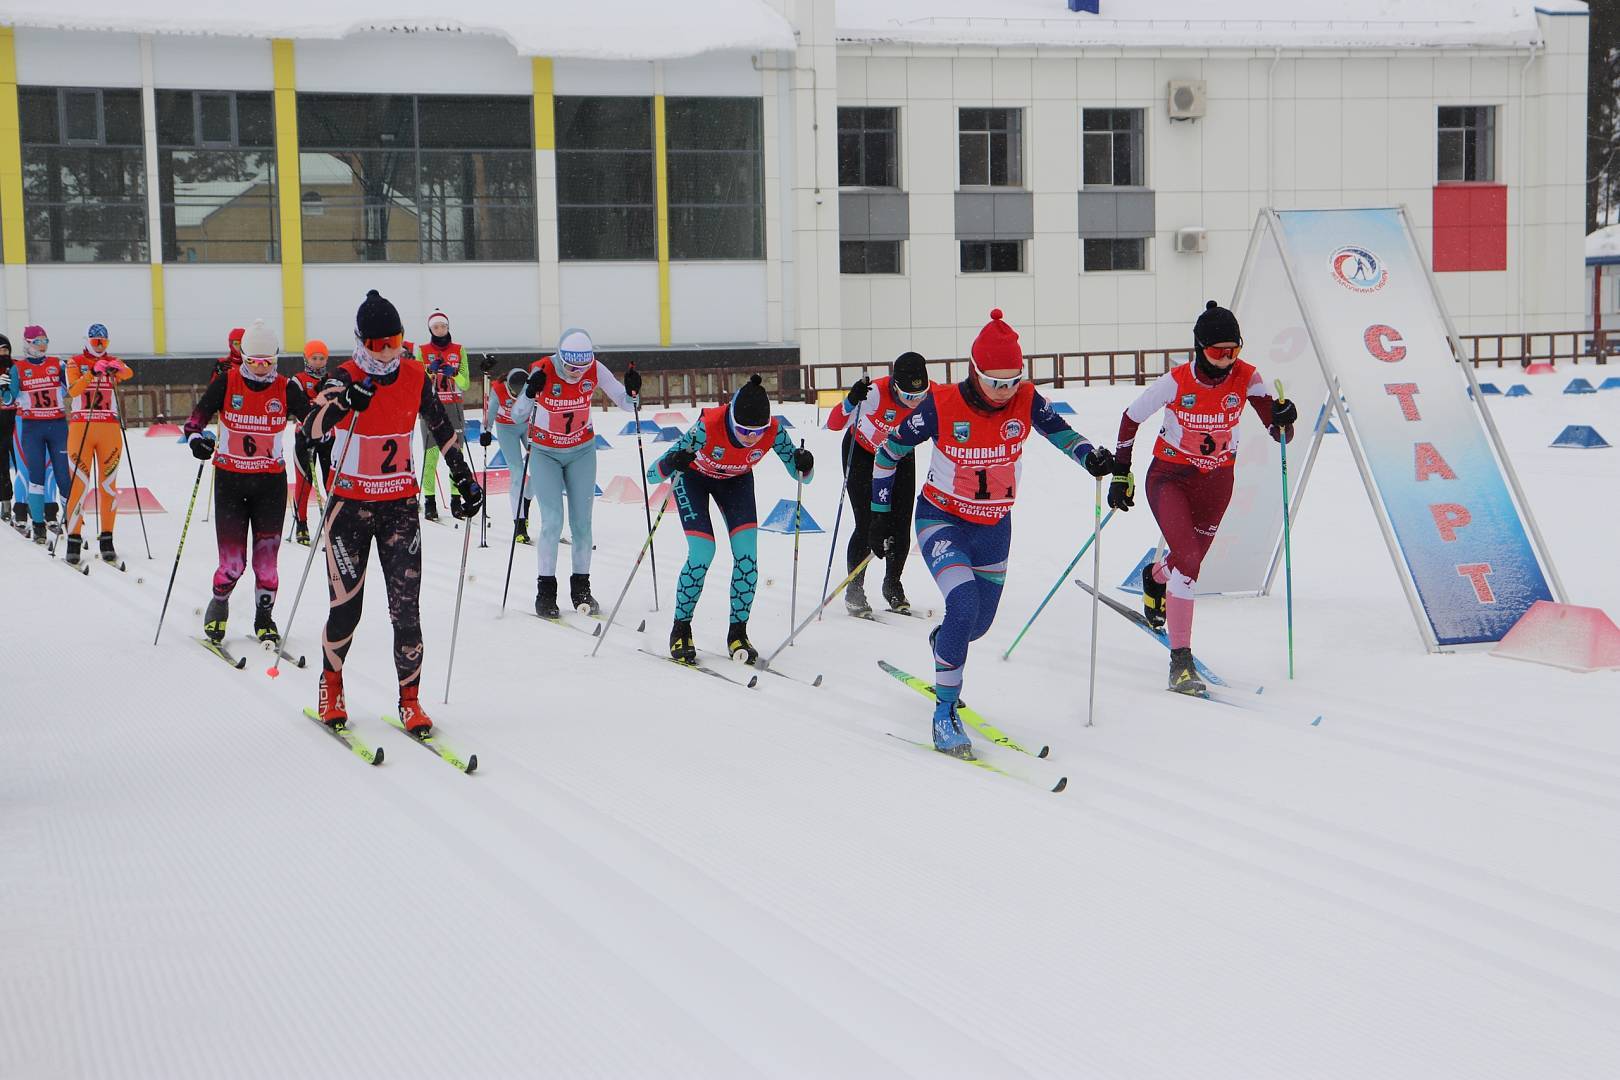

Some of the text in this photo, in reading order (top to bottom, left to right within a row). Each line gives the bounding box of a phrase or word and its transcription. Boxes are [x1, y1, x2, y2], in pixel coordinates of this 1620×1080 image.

[33, 390, 51, 407] 15
[84, 391, 104, 410] 12
[562, 412, 575, 434] 7
[242, 434, 257, 457] 6
[944, 444, 1006, 459] СОСНОВЫЙ
[1200, 432, 1216, 455] 3
[381, 439, 398, 474] 2
[1363, 324, 1496, 603] СТАРТ
[357, 478, 412, 489] ТЮМЕНСКАЯ
[364, 485, 404, 495] ОБЛАСТЬ
[975, 469, 991, 500] 1
[1005, 486, 1013, 498] 1
[959, 507, 1005, 519] ОБЛАСТЬ
